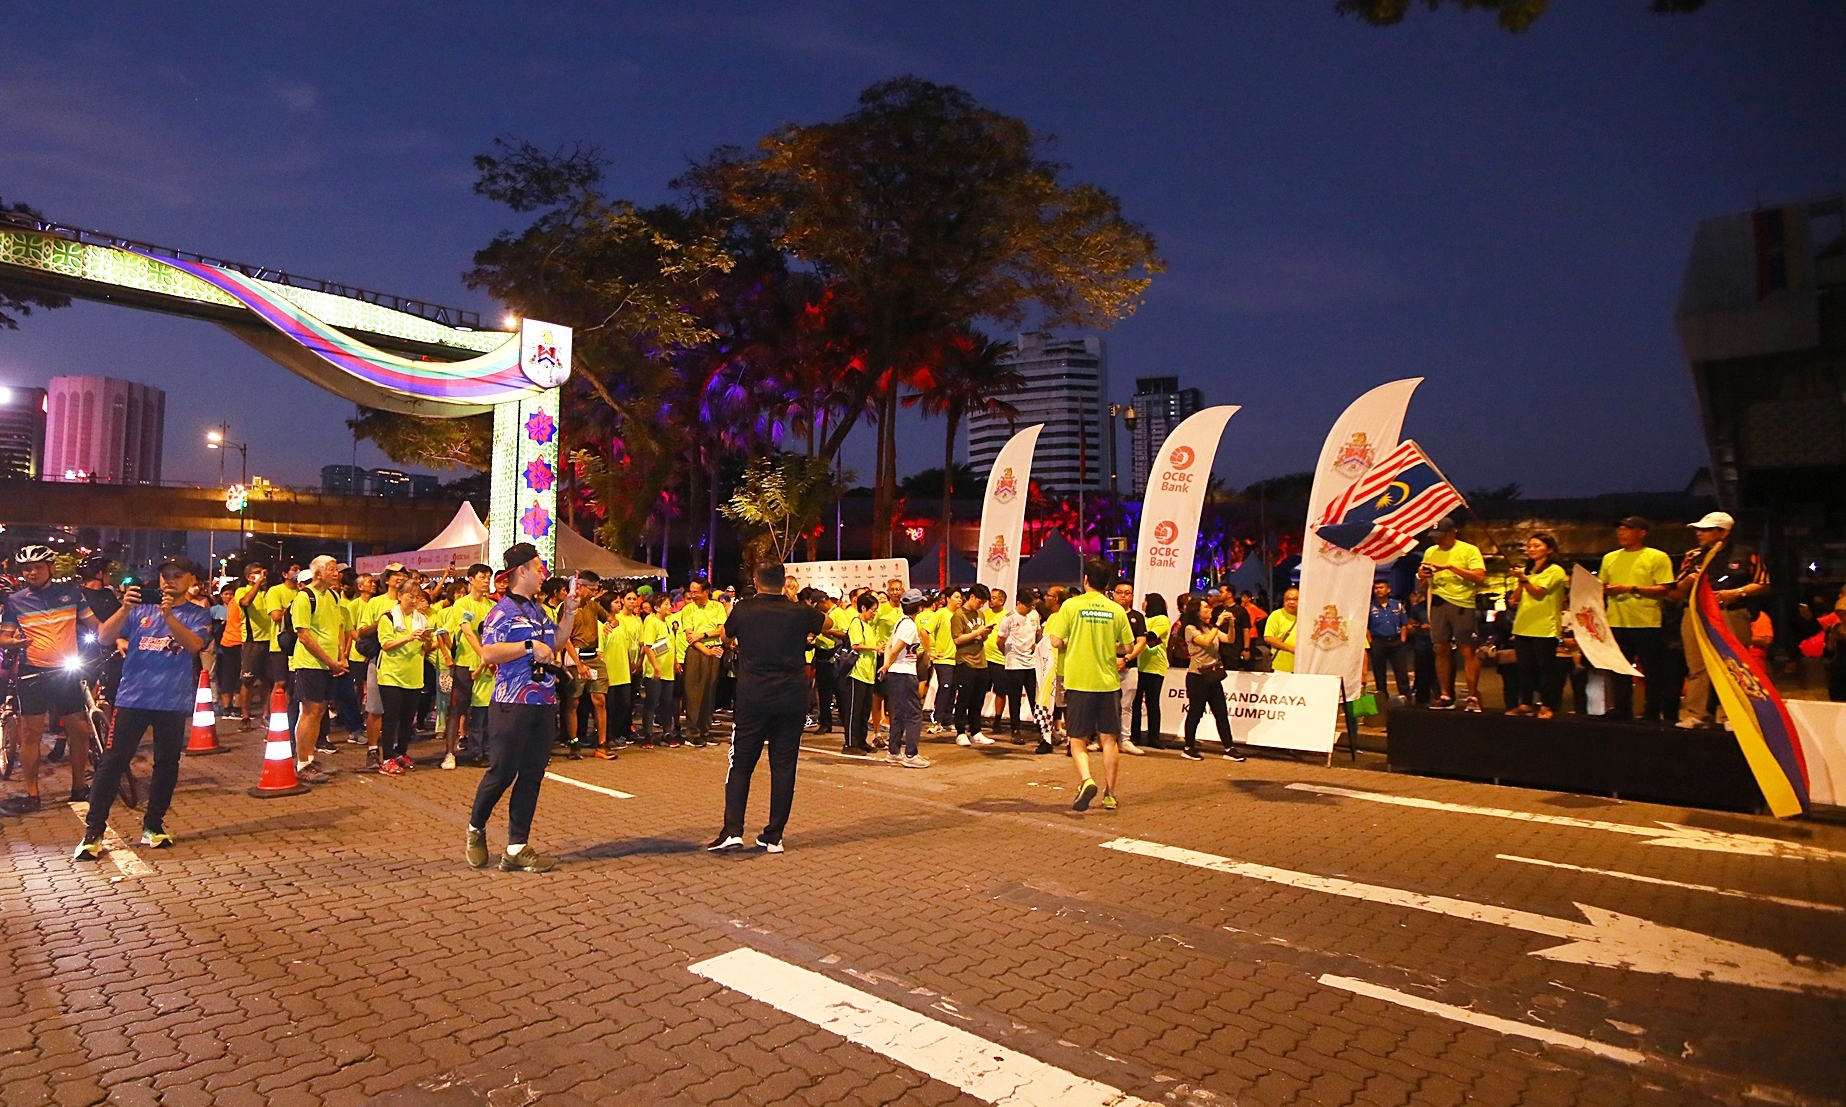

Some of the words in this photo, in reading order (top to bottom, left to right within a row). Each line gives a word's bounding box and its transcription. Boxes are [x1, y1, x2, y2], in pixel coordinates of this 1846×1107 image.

[1162, 471, 1194, 483] OCBC
[1161, 481, 1189, 493] Bank
[1149, 546, 1179, 557] OCBC
[1150, 556, 1176, 568] Bank
[1228, 706, 1286, 721] LUMPUR
